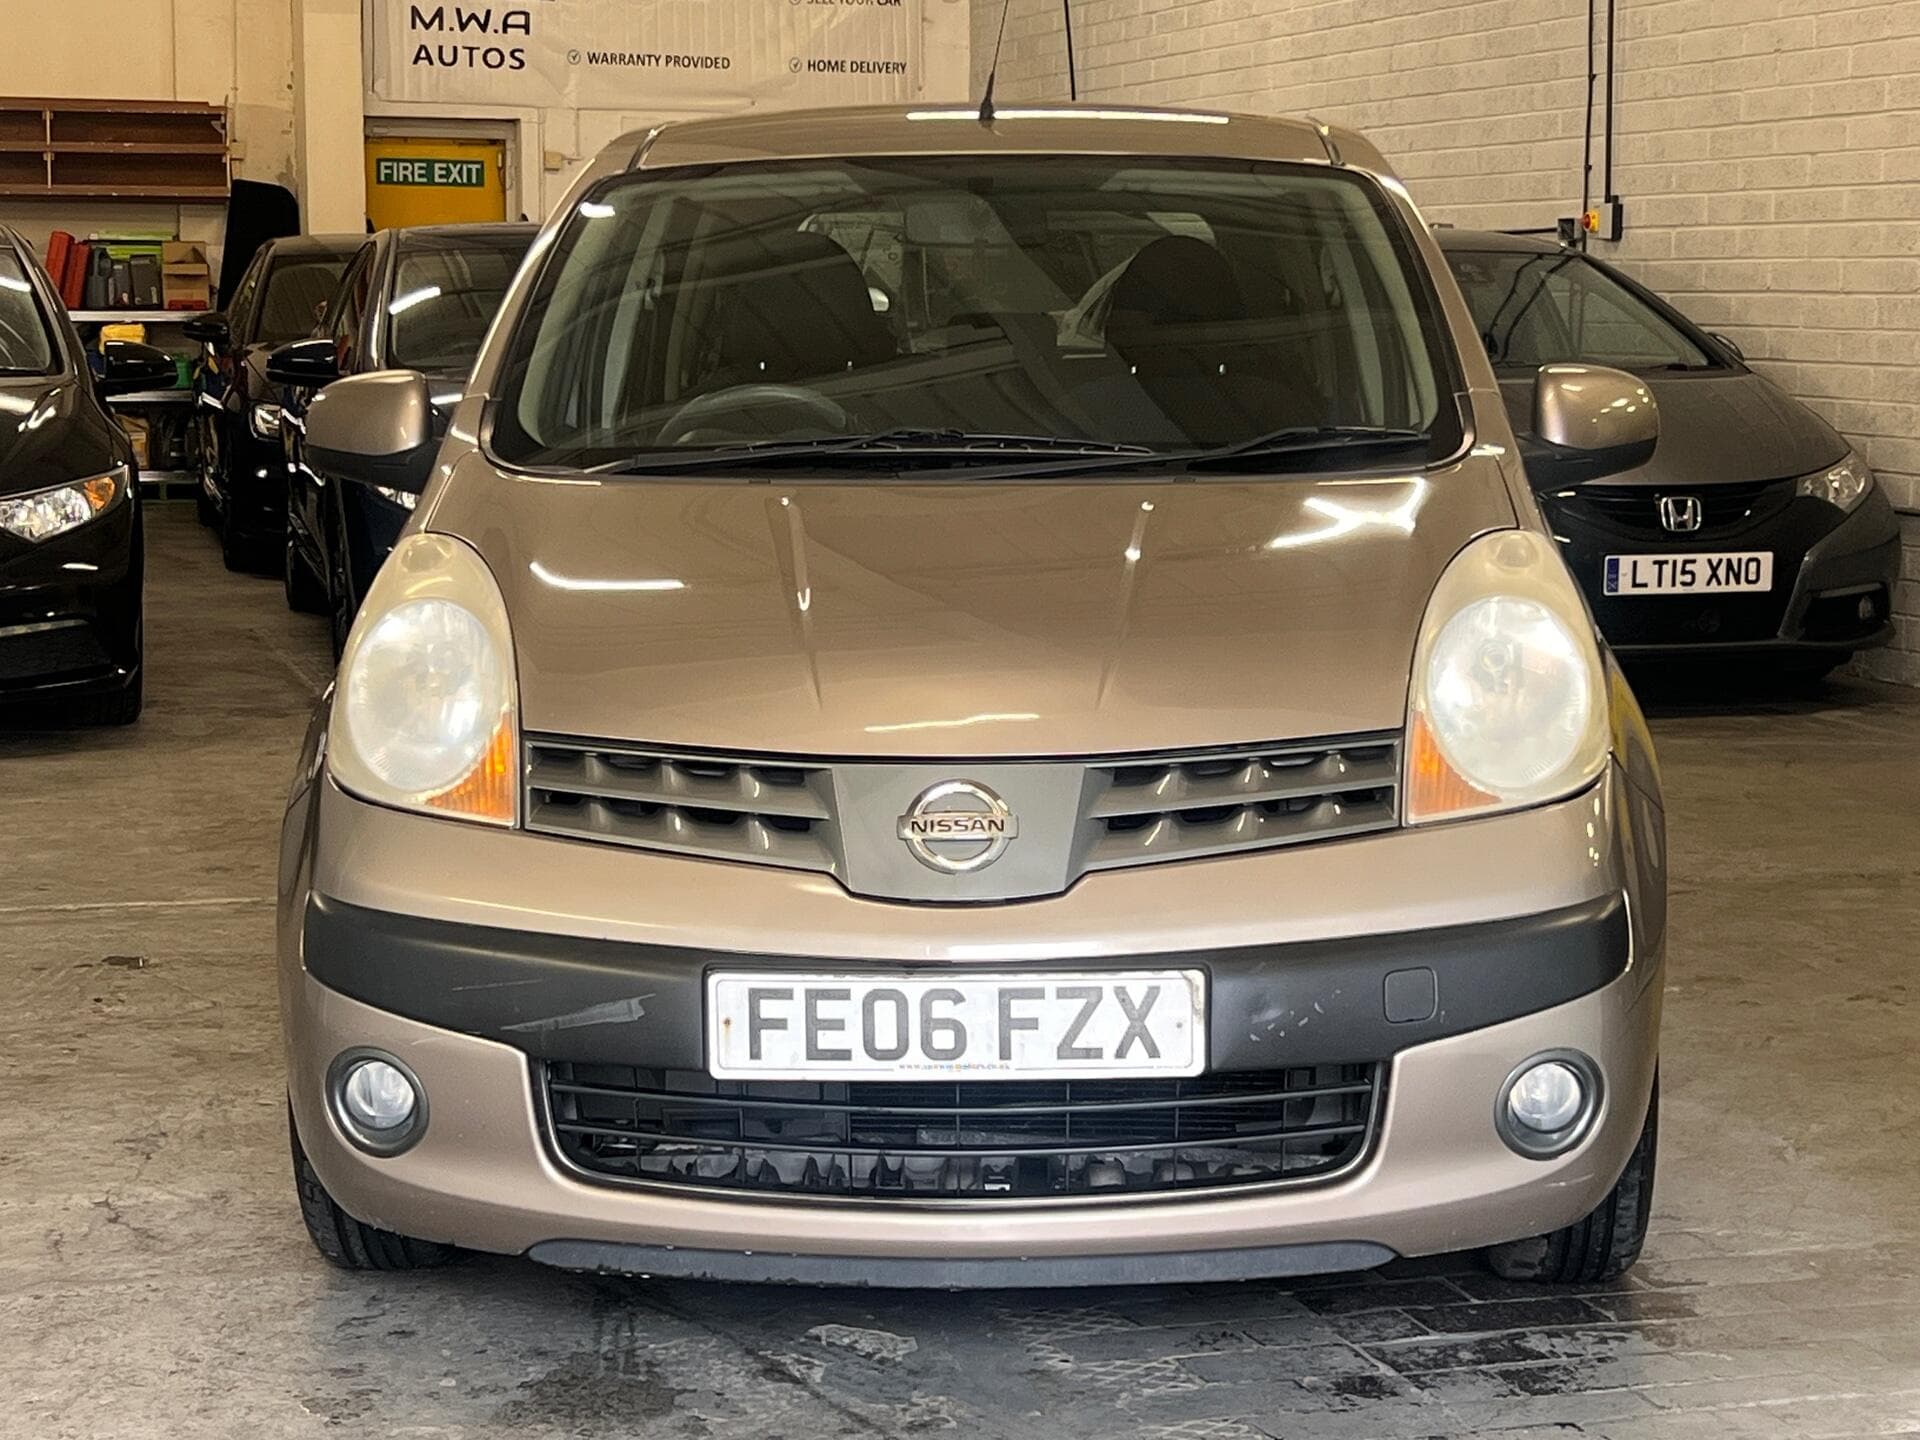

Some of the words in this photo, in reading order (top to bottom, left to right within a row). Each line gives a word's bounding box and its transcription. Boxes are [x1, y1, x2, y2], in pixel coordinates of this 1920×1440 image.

[410, 5, 530, 36] M.W.A
[412, 44, 526, 70] AUTOS
[586, 51, 662, 67] WARRANTY
[665, 54, 731, 70] PROVIDED
[807, 59, 847, 73] HOME
[850, 61, 908, 75] DELIVERY
[380, 161, 428, 183] FIRE
[433, 162, 482, 184] EXIT
[1631, 558, 1697, 589] LT15
[1705, 556, 1762, 587] XNO
[911, 819, 1005, 833] NISSAN
[747, 987, 968, 1062] FE06
[997, 985, 1162, 1061] FZX
